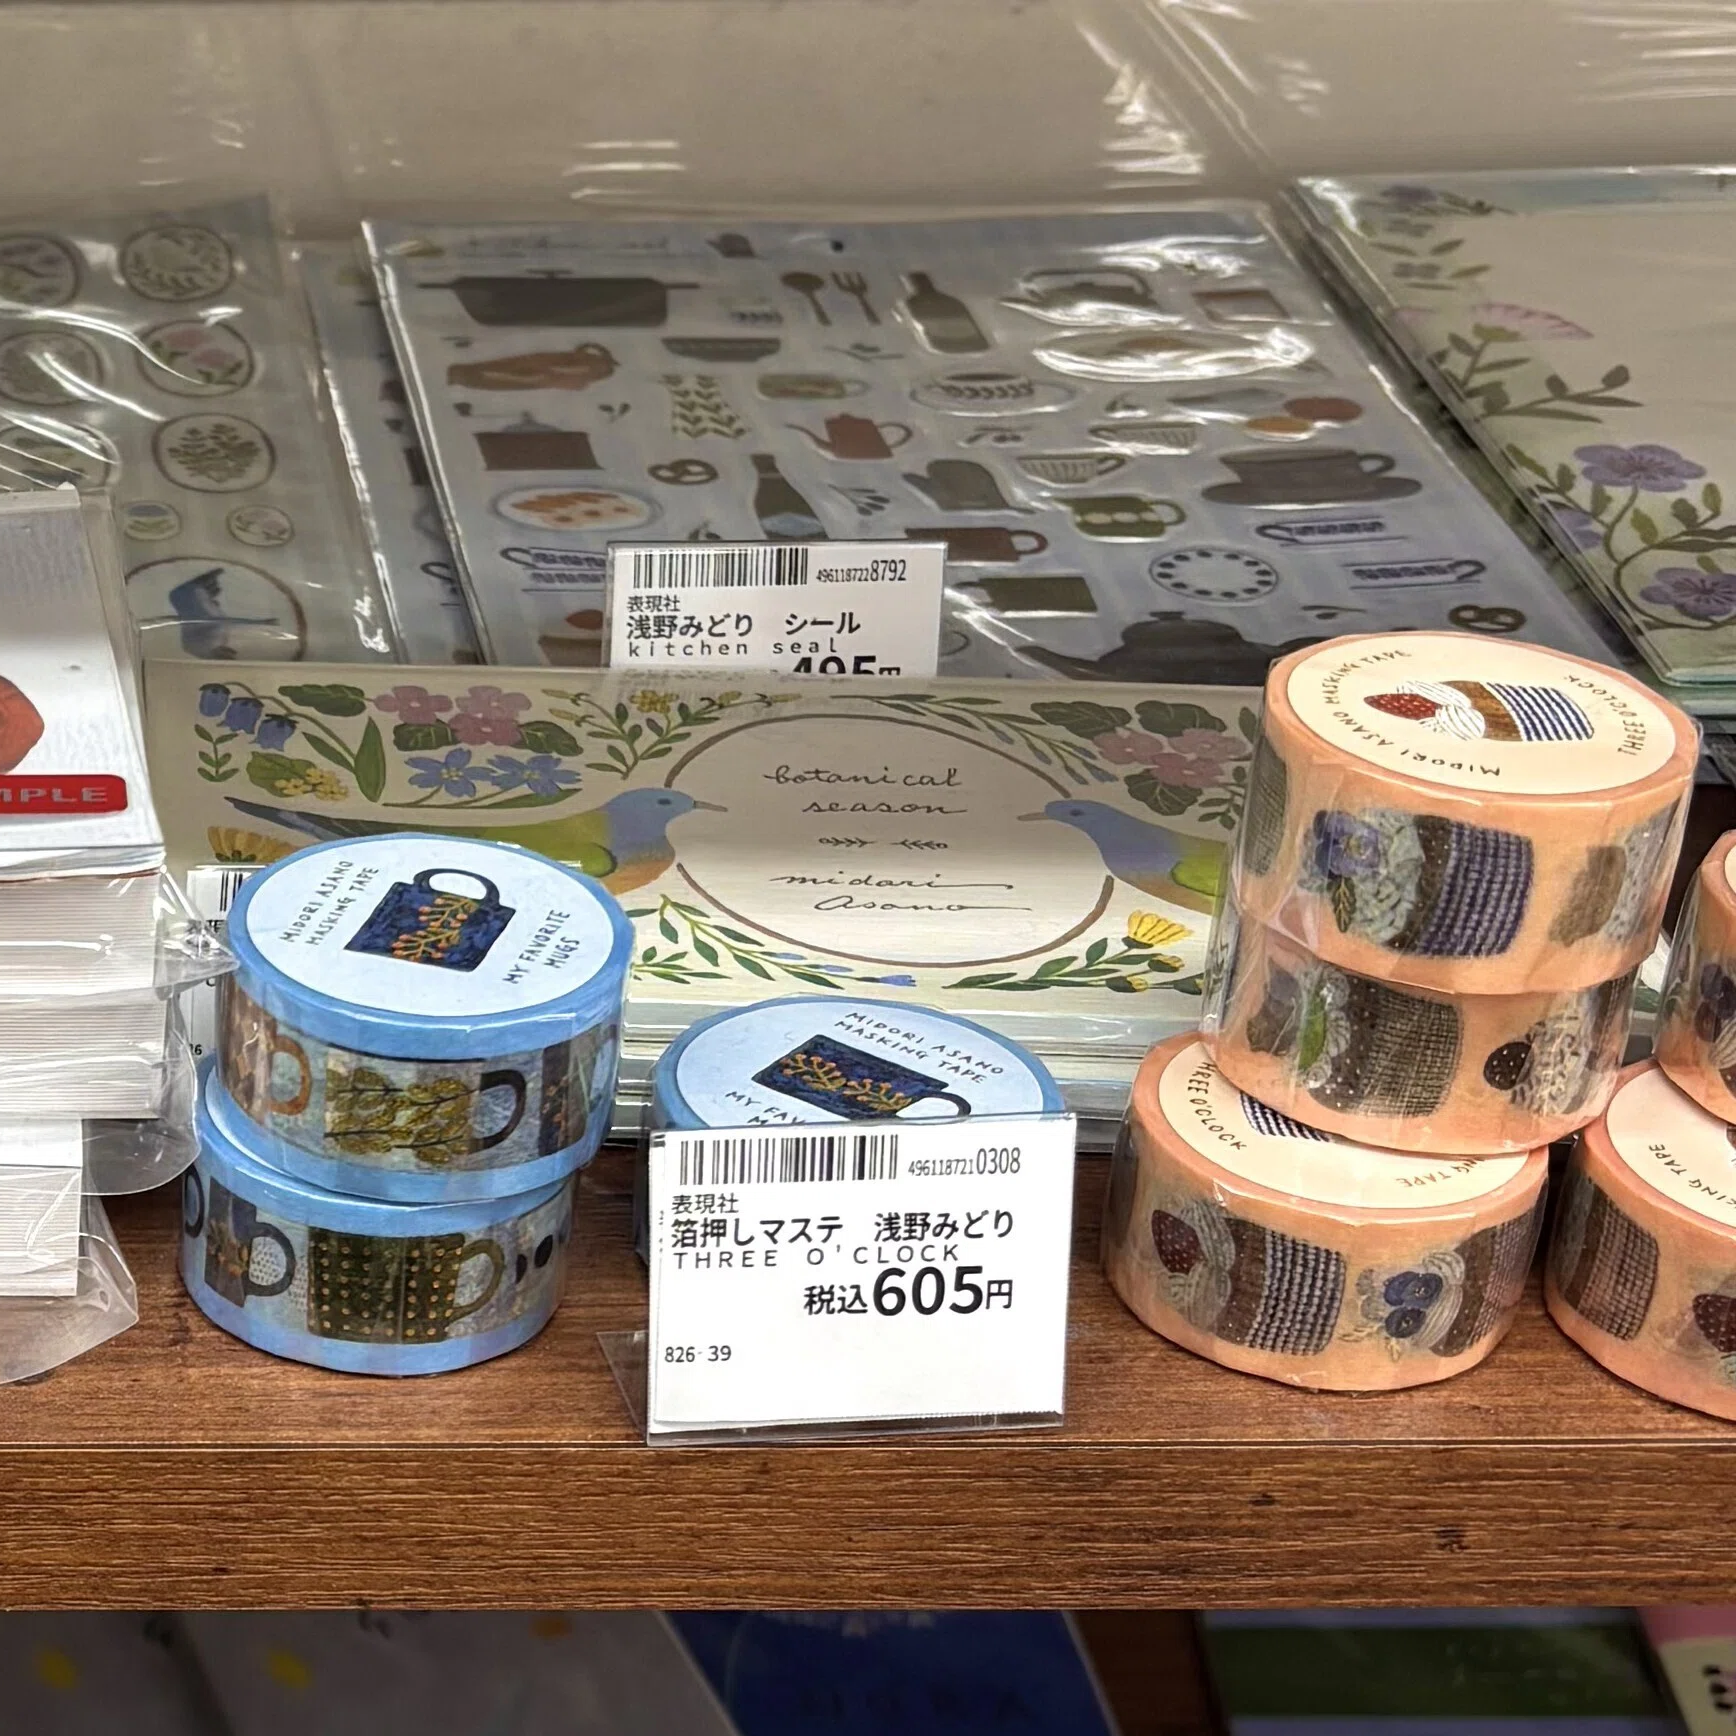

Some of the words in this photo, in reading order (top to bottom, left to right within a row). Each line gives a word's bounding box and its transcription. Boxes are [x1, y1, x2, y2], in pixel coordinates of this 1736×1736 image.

[627, 595, 681, 613] 表現社
[626, 613, 754, 640] 浅野みどり
[784, 611, 862, 635] シール
[628, 640, 749, 658] kitchen
[772, 637, 838, 654] seal
[279, 900, 321, 944] MIDORI
[320, 859, 355, 900] ASANO
[834, 1020, 930, 1061] MASKING
[844, 1011, 926, 1046] MIDORI
[932, 1044, 1005, 1076] ASANO
[1187, 1061, 1218, 1095] HREE
[907, 1148, 1022, 1177] 4961187210308
[671, 1193, 740, 1215] 表現社
[670, 1215, 844, 1249] 箔押しマステ
[873, 1210, 1015, 1243] 浅野みどり
[674, 1250, 779, 1270] THREE
[803, 1265, 1014, 1317] 税込605円
[707, 1344, 732, 1362] 39
